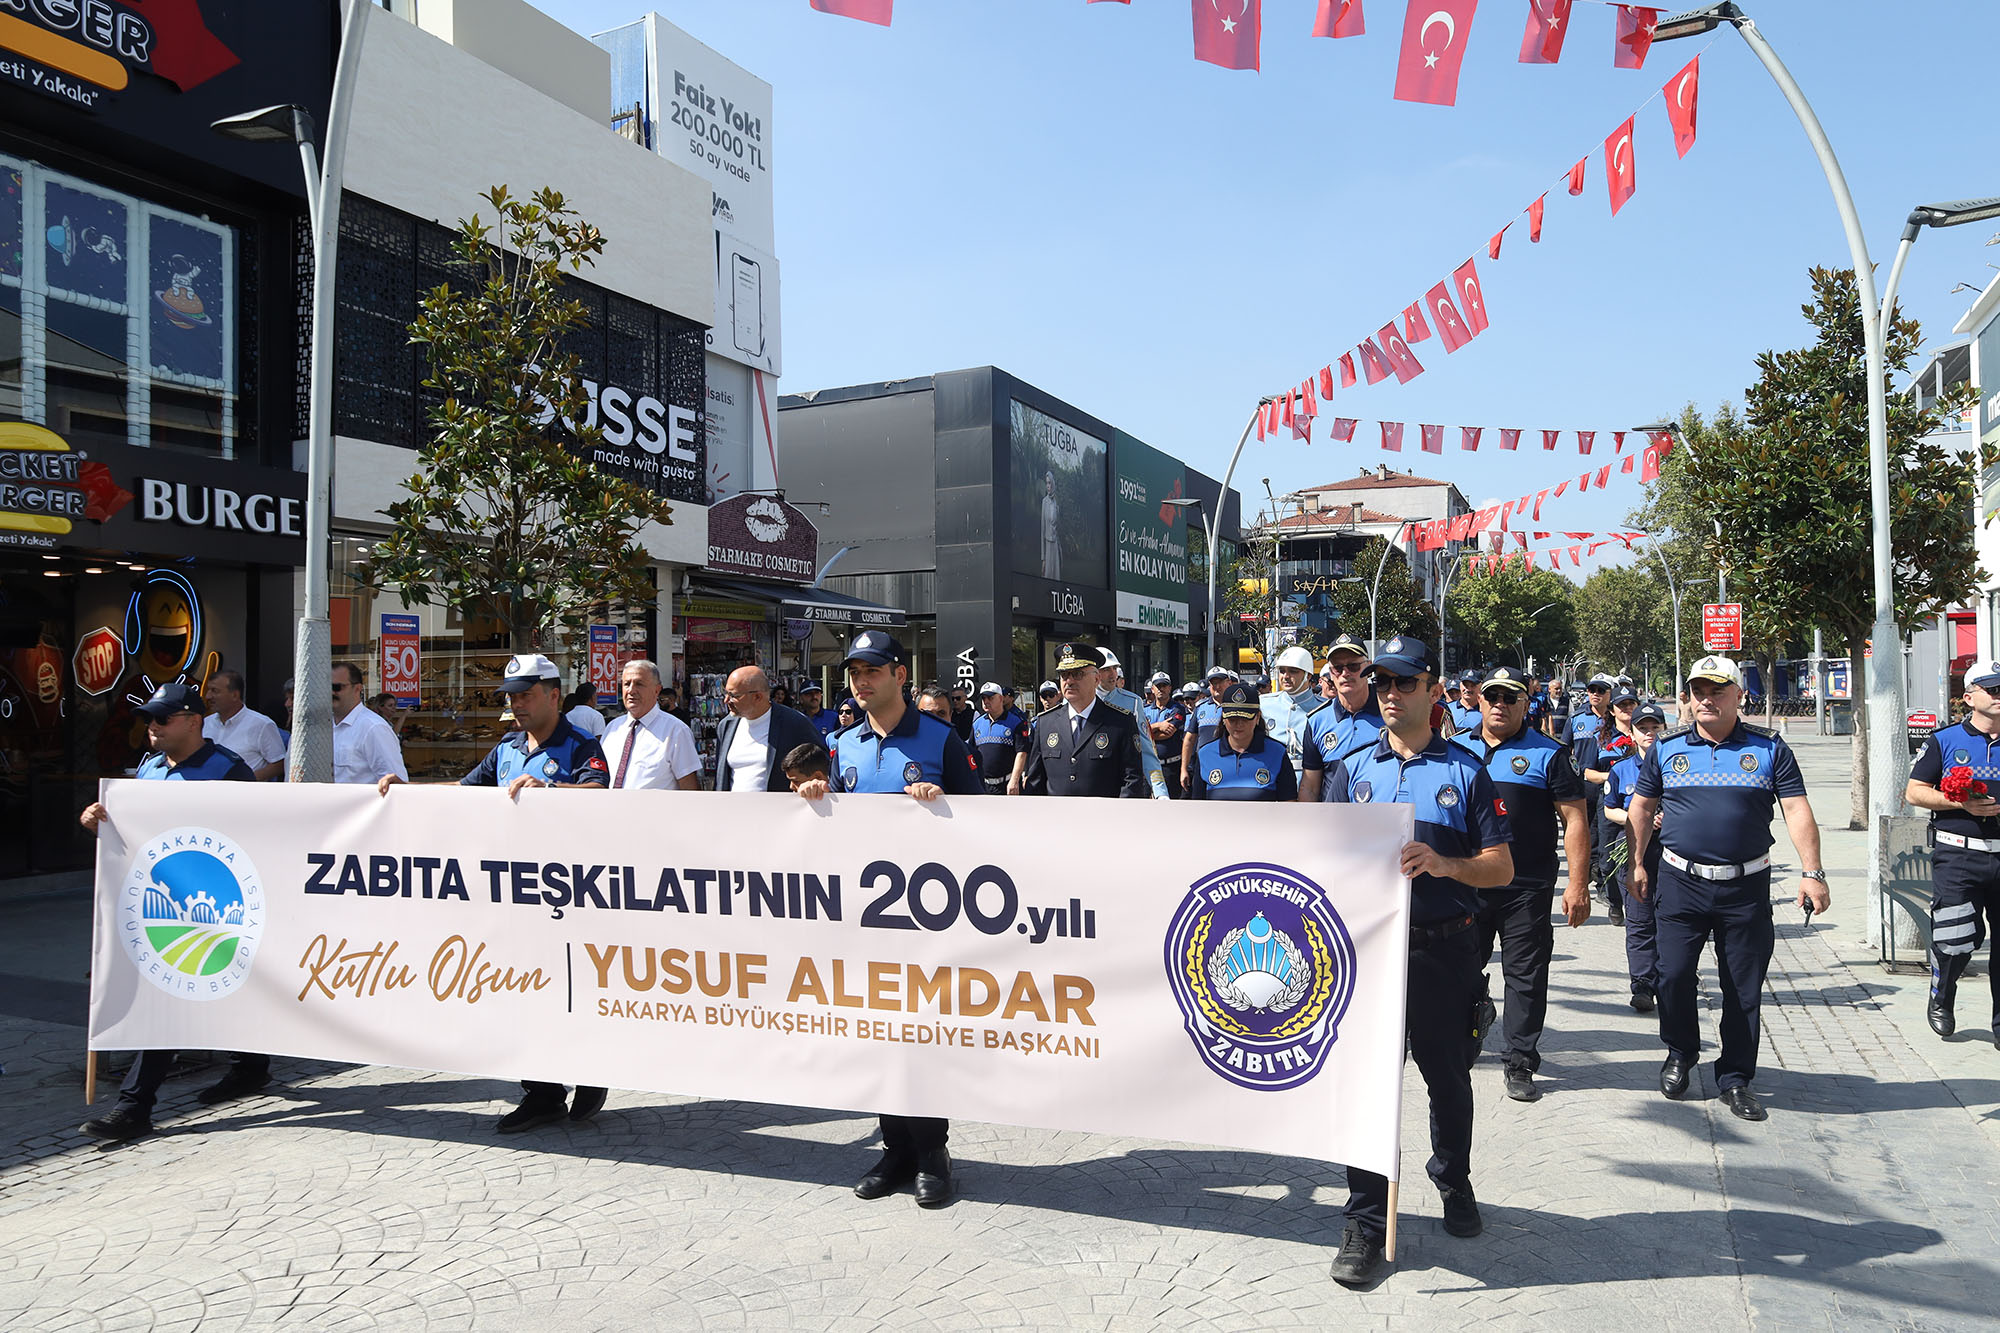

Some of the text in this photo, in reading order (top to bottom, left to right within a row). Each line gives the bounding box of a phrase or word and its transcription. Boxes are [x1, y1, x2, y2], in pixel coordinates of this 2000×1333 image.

[0, 0, 150, 62] GER
[674, 69, 761, 142] Faiz Yok!
[671, 100, 766, 171] 200.000 TL
[690, 138, 751, 183] 50 ay vade
[1044, 423, 1079, 456] TUĞBA
[593, 450, 695, 481] made with gusto
[143, 478, 310, 536] BURGE
[708, 545, 813, 575] STARMAKE COSMETIC
[1120, 549, 1186, 585] EN KOLAY YOLU
[815, 608, 892, 624] STARMAKE COSMETIC
[1051, 588, 1085, 617] TUĞBA
[82, 641, 114, 685] STOP
[148, 835, 236, 864] SAKARYA
[304, 853, 471, 901] ZABITA
[1208, 876, 1309, 909] BÜYÜKŞEHİR
[125, 870, 197, 993] BÜYÜKŞEHİR
[298, 934, 551, 1004] Kutlu Olsun
[584, 943, 1097, 1027] YUSUF ALEMDAR
[598, 998, 1099, 1058] SAKARYA BÜYÜKŞEHİR BELEDİYE BAŞKANI
[1209, 1036, 1313, 1074] ZABITA
